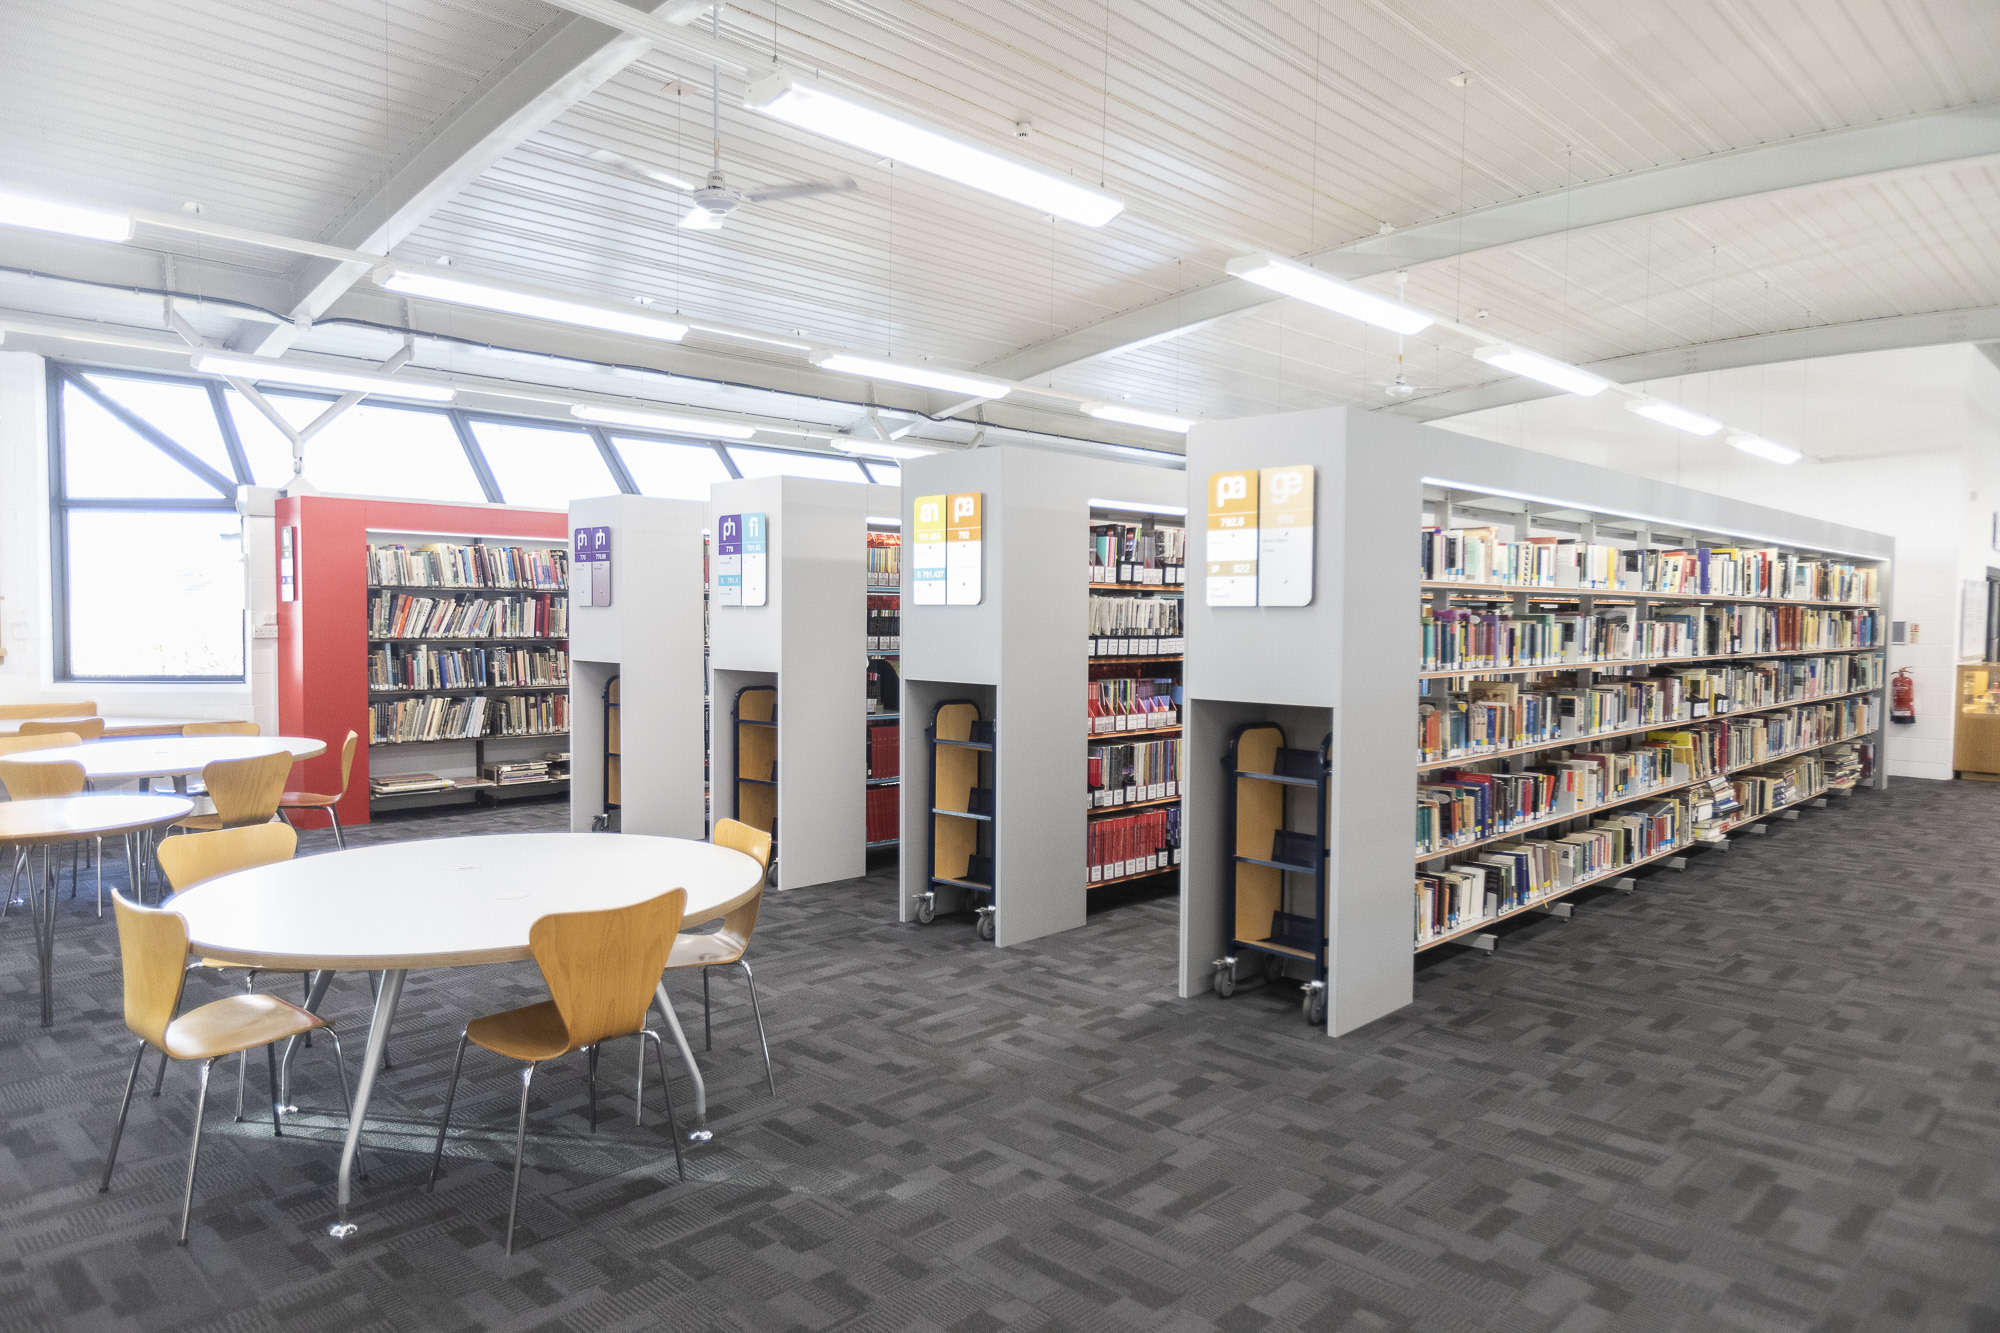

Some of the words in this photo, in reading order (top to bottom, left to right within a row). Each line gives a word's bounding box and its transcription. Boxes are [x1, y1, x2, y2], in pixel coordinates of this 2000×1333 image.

[1216, 475, 1246, 508] pa
[1270, 471, 1304, 504] ge
[920, 502, 939, 523] an
[954, 496, 975, 523] pa
[723, 517, 736, 541] ph
[748, 516, 759, 538] fi
[577, 530, 588, 551] ph
[595, 528, 606, 550] ph
